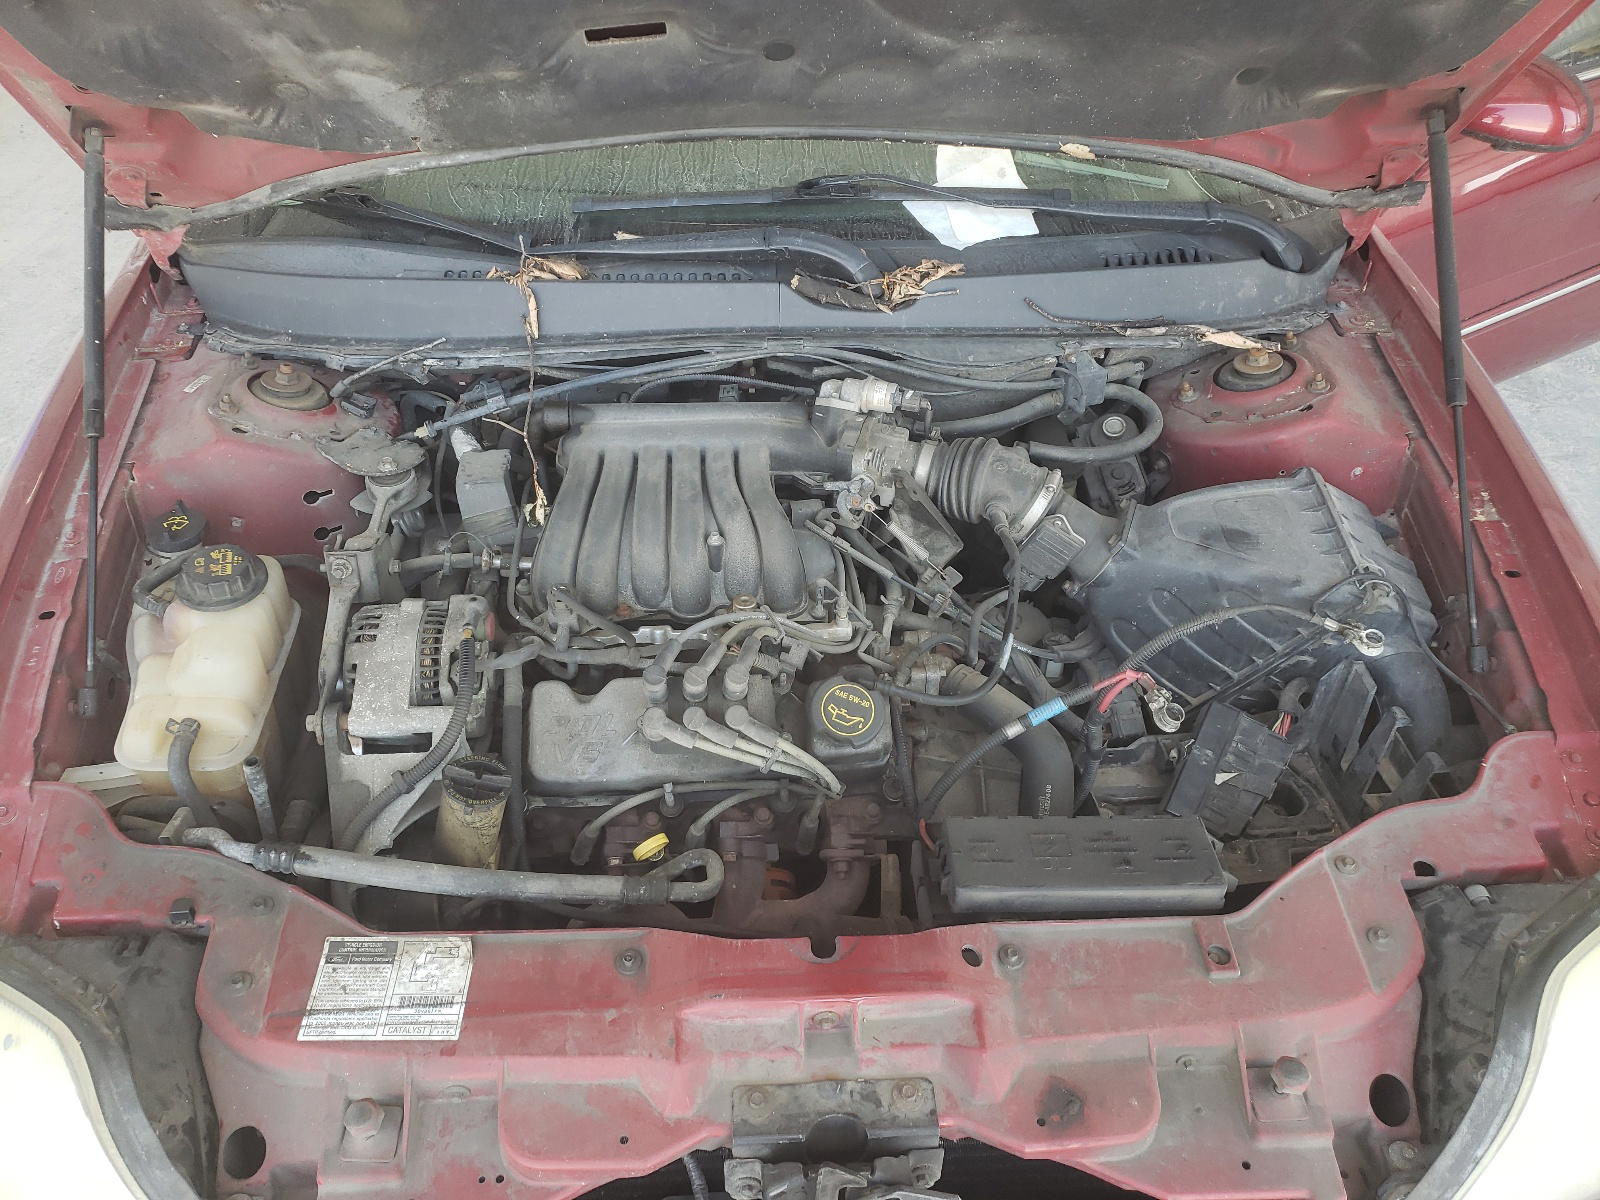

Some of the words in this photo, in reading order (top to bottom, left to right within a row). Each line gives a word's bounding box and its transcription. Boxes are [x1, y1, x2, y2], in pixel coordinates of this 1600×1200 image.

[834, 689, 848, 699] SAE
[848, 695, 870, 708] 5W-20
[387, 1026, 428, 1034] CATALYST
